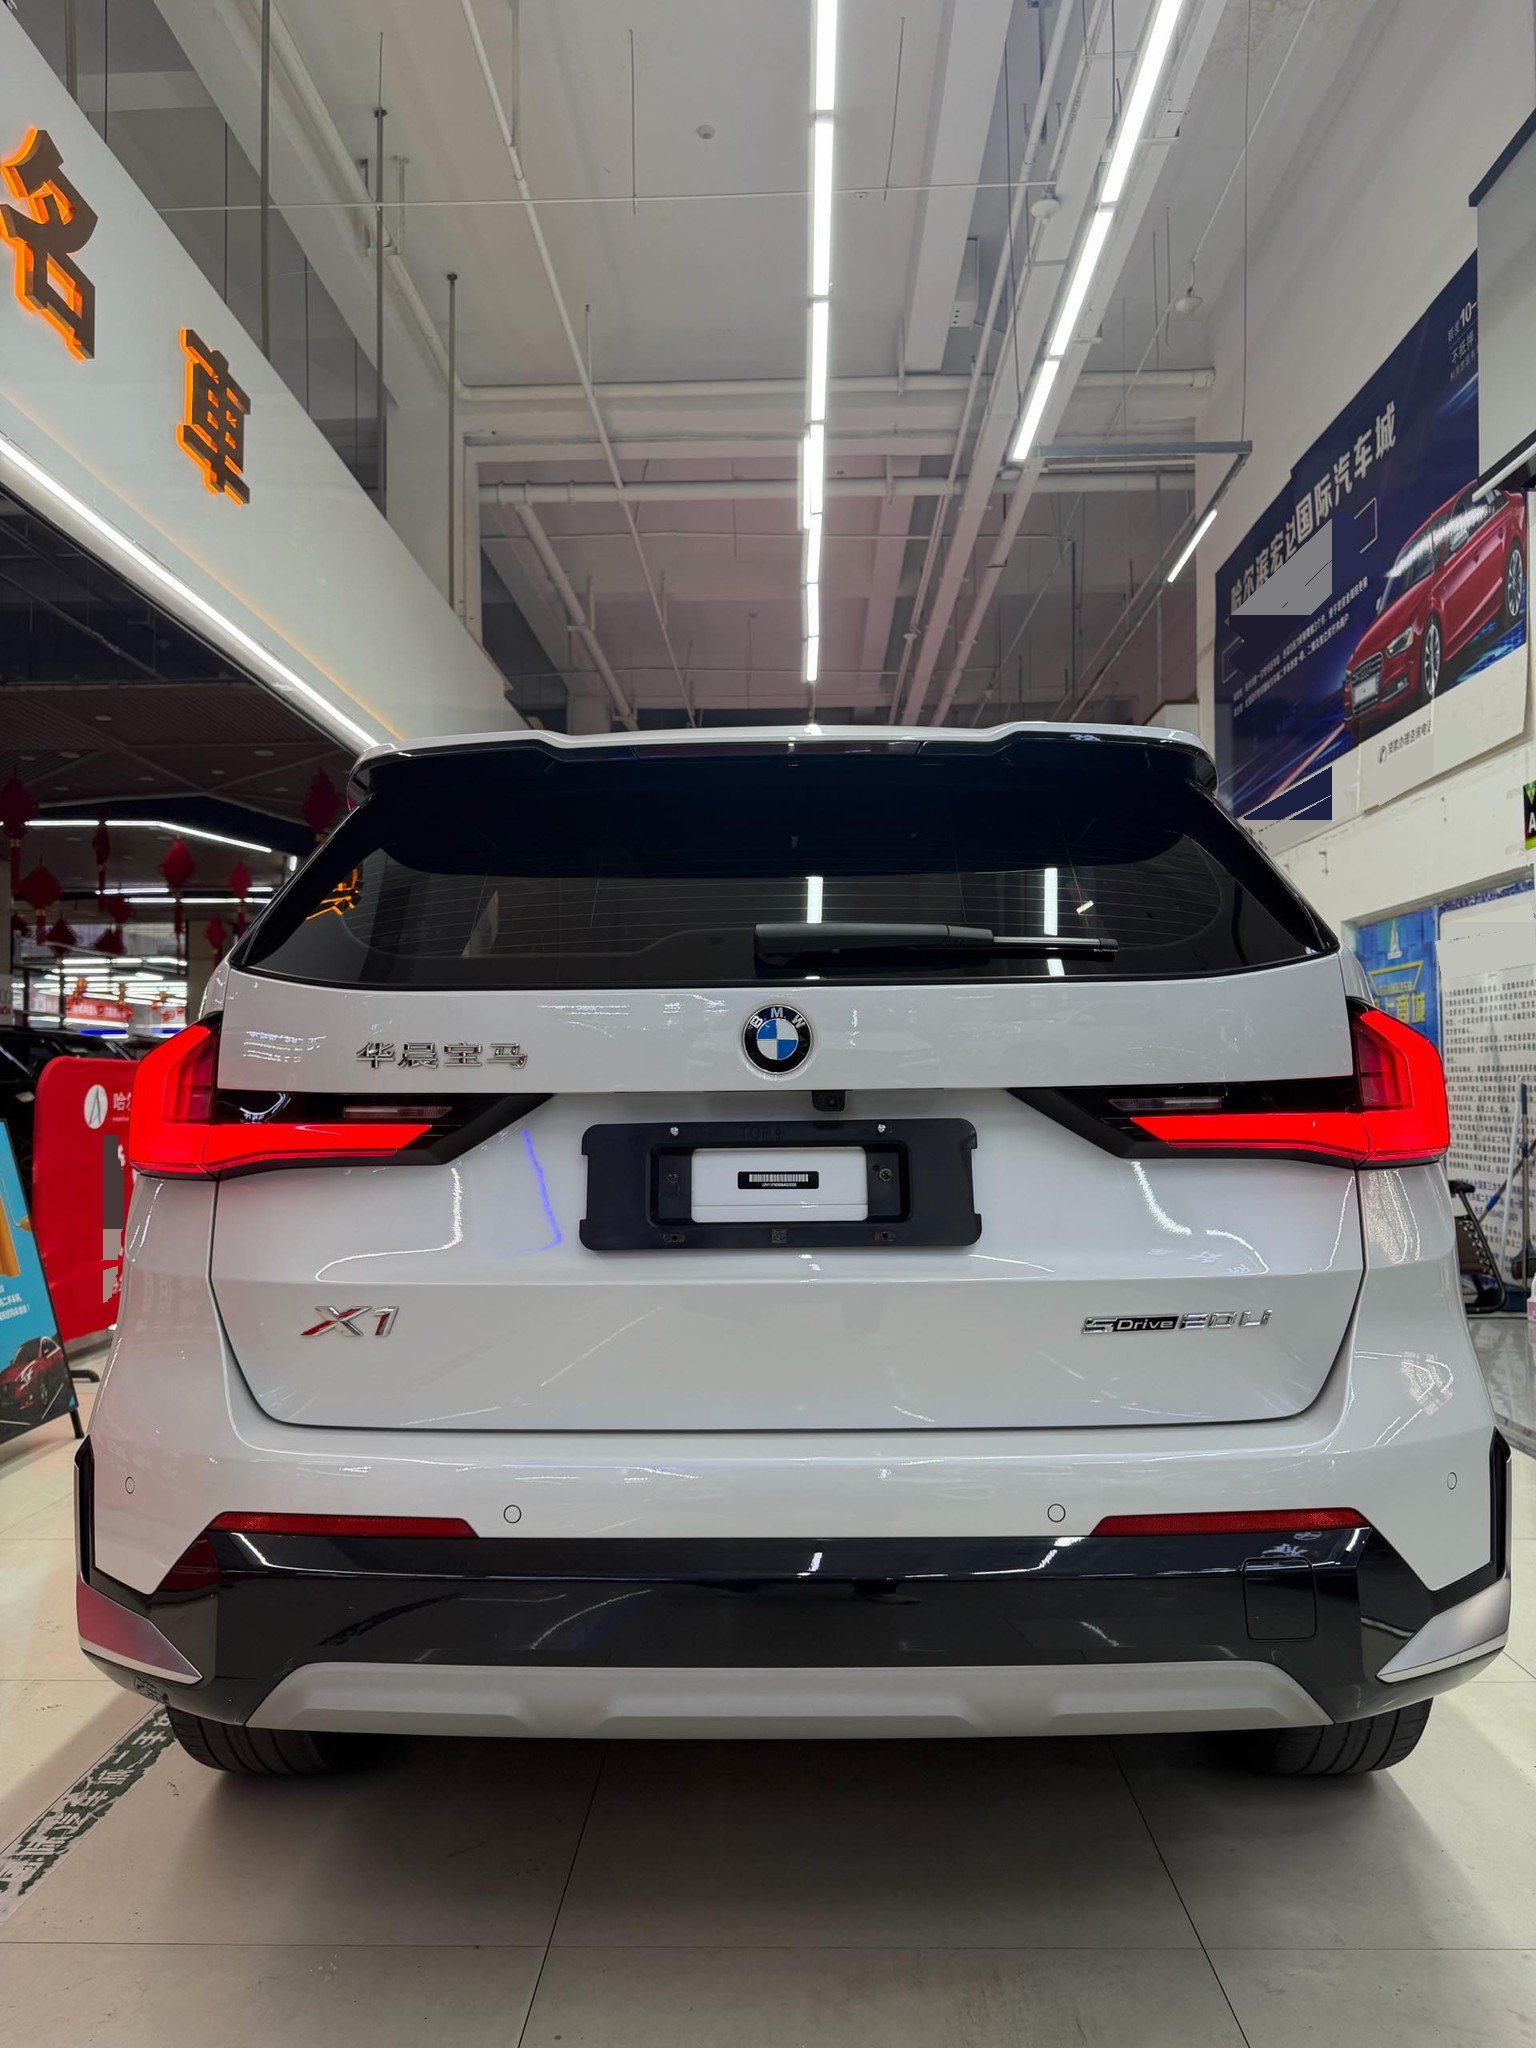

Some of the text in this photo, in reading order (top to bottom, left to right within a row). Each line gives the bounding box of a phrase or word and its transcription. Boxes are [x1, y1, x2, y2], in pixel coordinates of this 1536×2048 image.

[750, 1007, 806, 1029] BMW
[355, 1041, 528, 1069] 华晨宝马
[300, 1305, 399, 1337] X1
